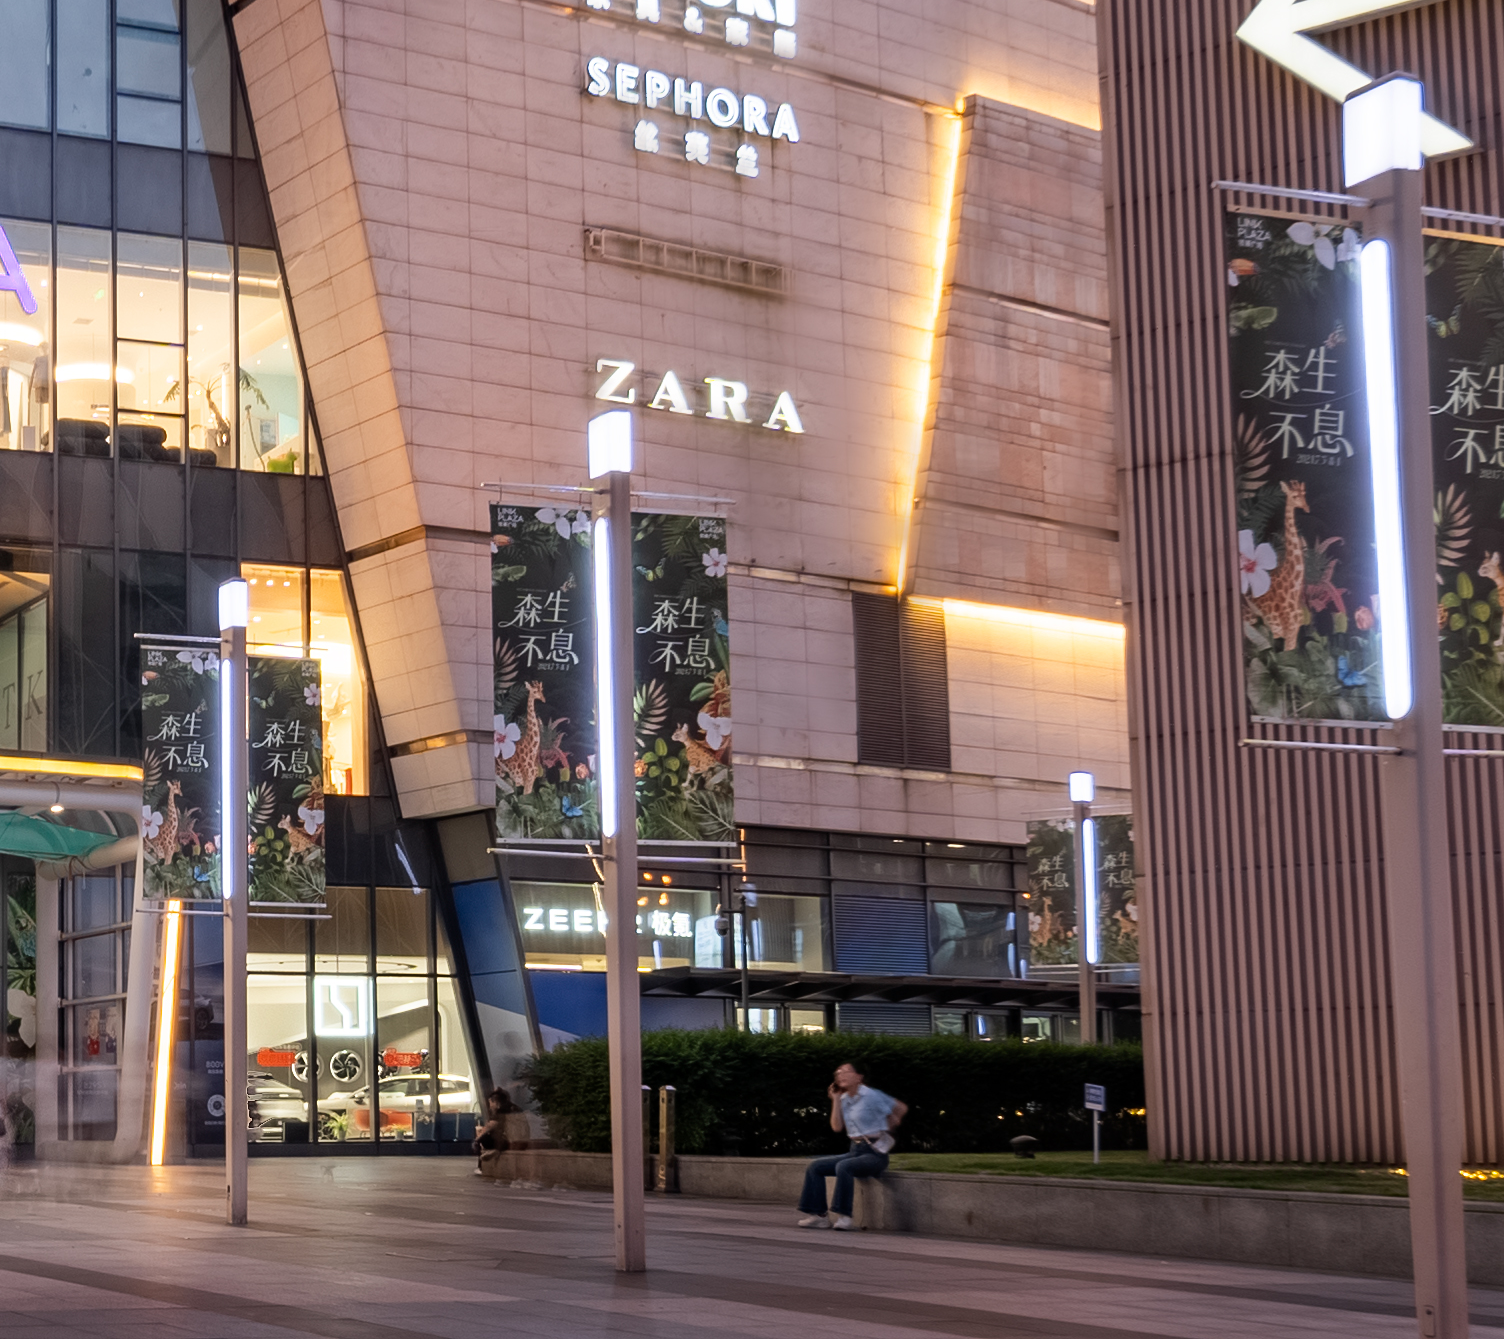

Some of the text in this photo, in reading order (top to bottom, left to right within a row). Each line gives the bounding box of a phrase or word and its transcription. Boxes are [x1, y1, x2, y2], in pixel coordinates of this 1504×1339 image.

[587, 55, 801, 143] SEPHORA
[1246, 345, 1338, 400] 森生
[594, 358, 805, 434] ZARA
[1263, 403, 1355, 460] 不息
[503, 589, 571, 628] 森生
[641, 596, 707, 634] 森生
[517, 628, 579, 668] 不息
[649, 634, 716, 673] 不息
[152, 711, 203, 742] 森生
[257, 719, 307, 749] 森生
[161, 740, 210, 771] 不息
[261, 747, 313, 778] 不息
